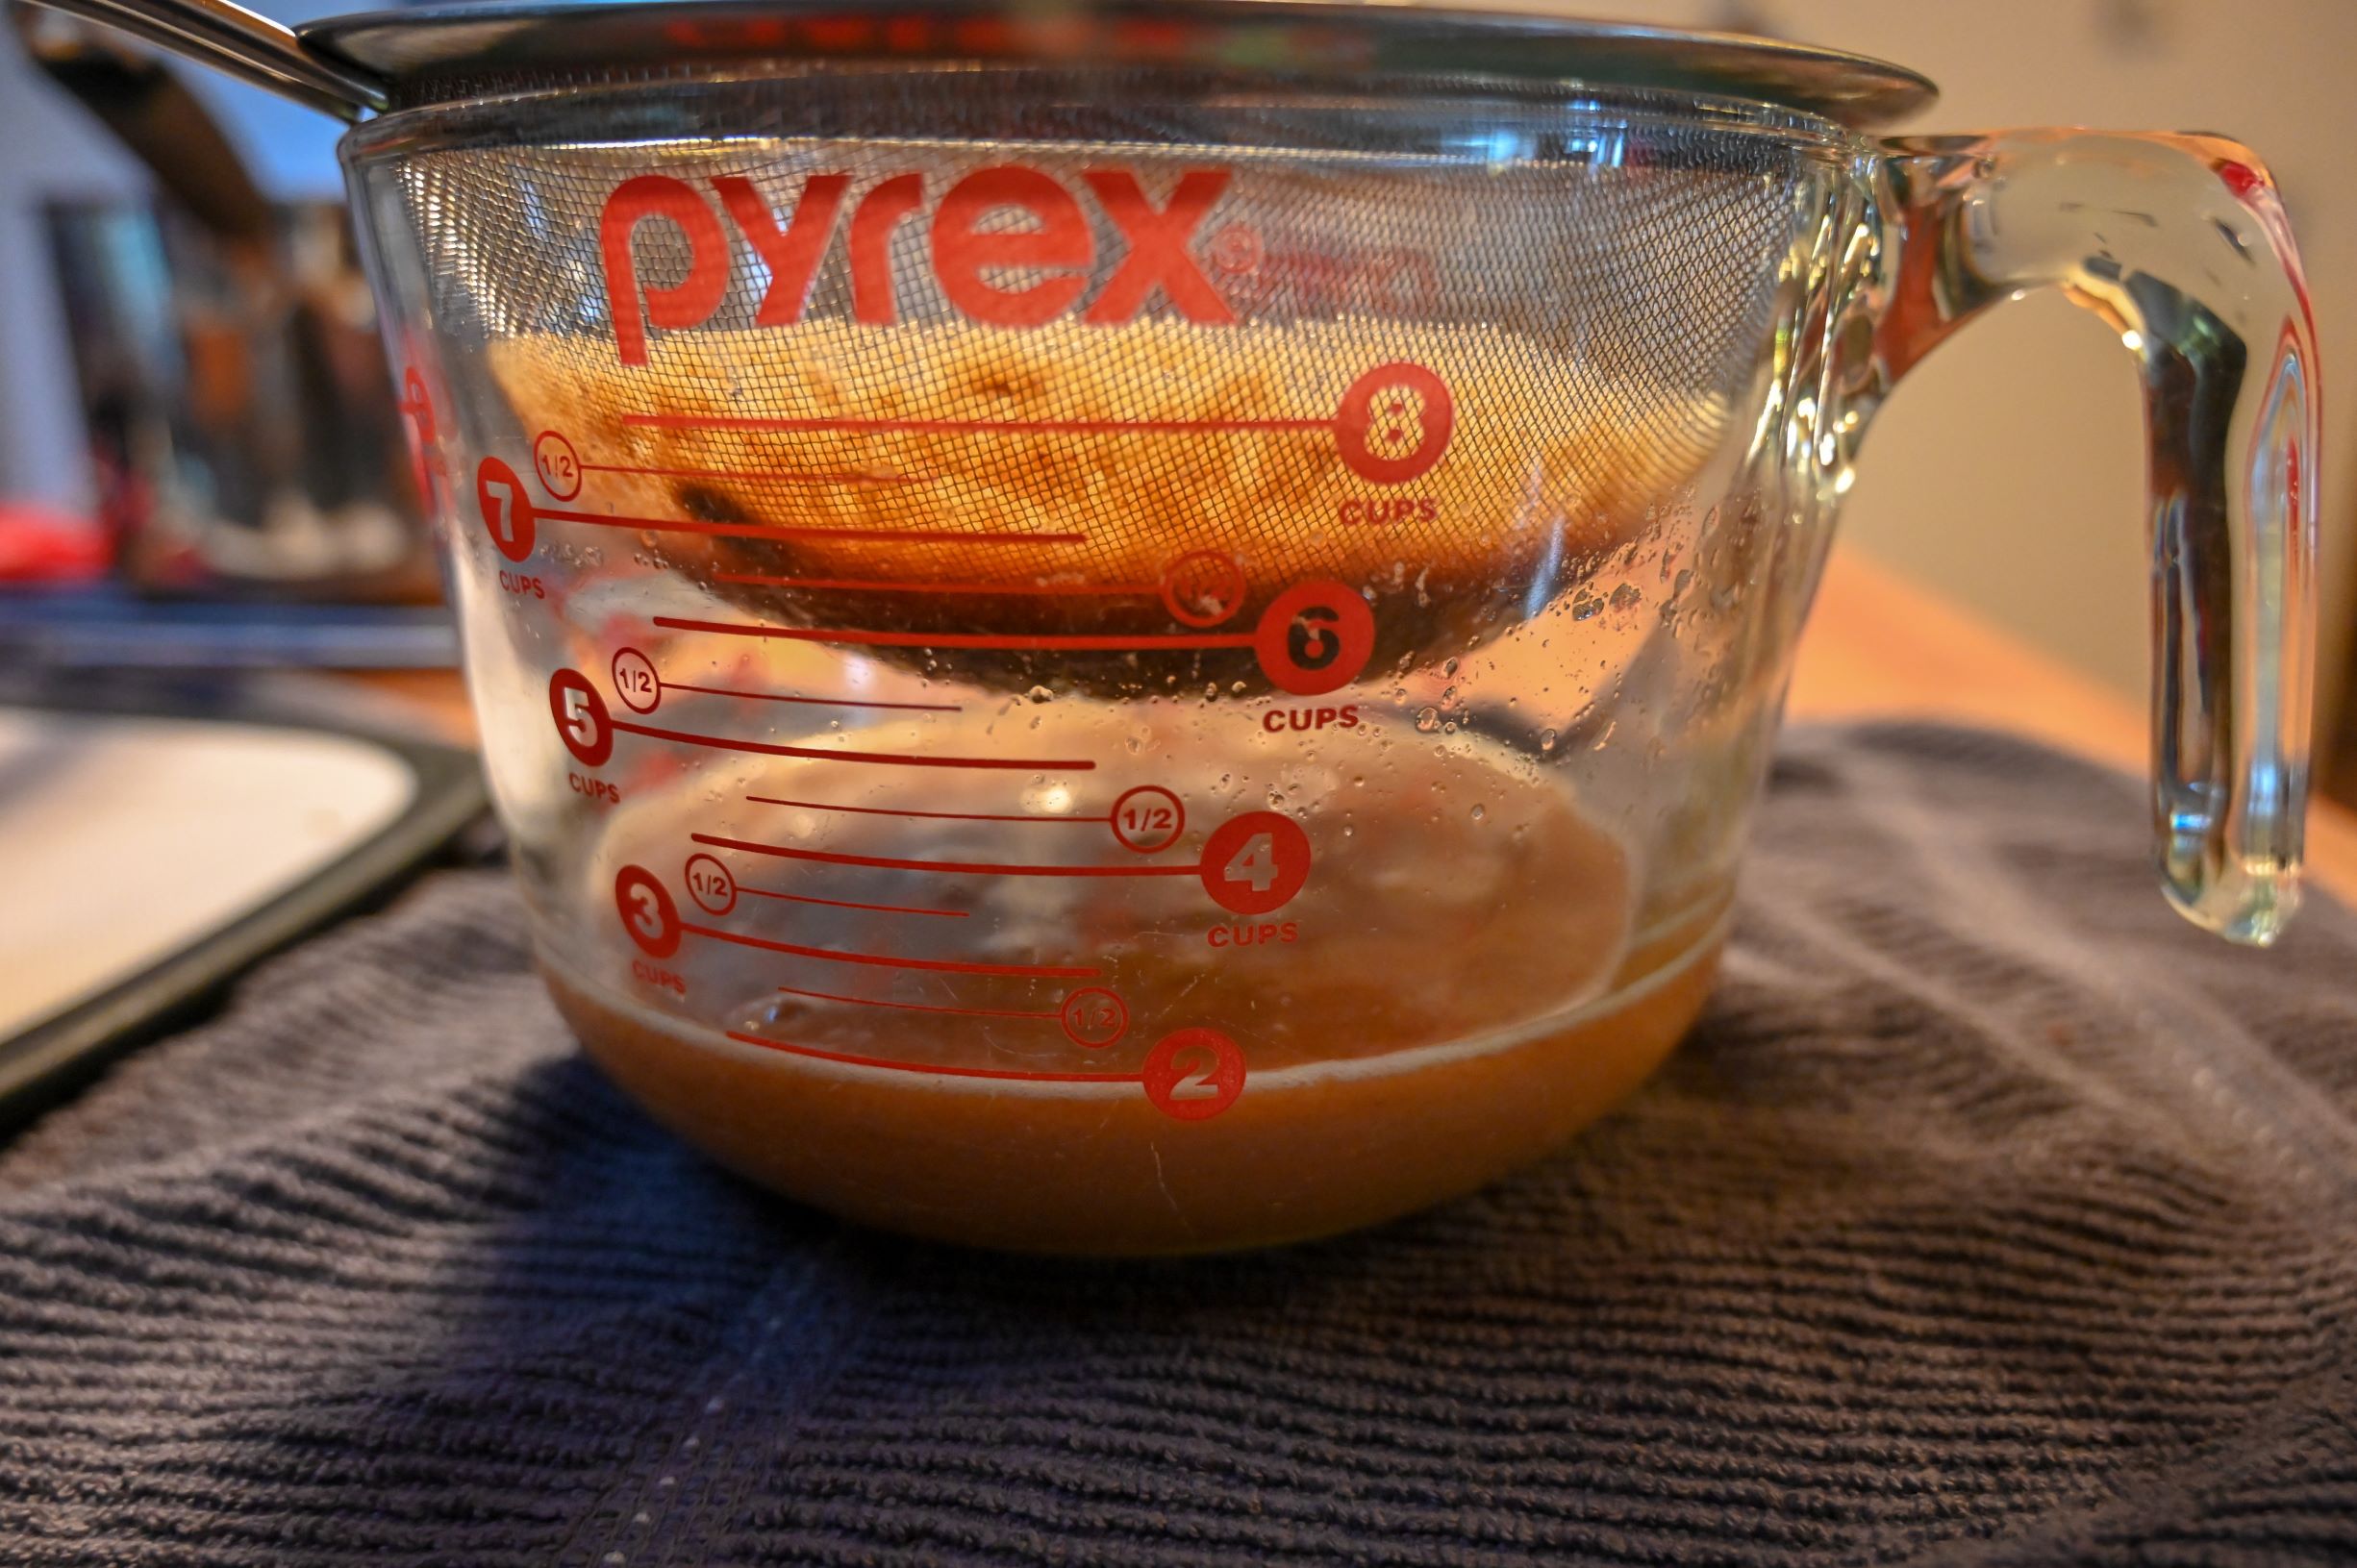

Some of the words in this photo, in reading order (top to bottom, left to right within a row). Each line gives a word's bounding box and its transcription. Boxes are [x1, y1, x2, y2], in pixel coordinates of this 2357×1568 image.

[600, 165, 1238, 366] pyrex
[1365, 385, 1426, 461] 8
[541, 455, 574, 479] 1/2
[485, 480, 514, 542] 7
[1339, 498, 1438, 526] CUPS
[499, 570, 545, 600] CUPS
[1288, 607, 1341, 670] 6
[619, 667, 652, 693] 1/2
[564, 686, 598, 748] 5
[1263, 705, 1359, 733] CUPS
[568, 772, 620, 804] CUPS
[1123, 808, 1172, 832] 1/2
[1223, 833, 1278, 892] 4
[692, 872, 728, 897] 1/2
[630, 883, 664, 939] 3
[1207, 922, 1298, 948] CUPS
[632, 959, 686, 994] CUPS
[1072, 1008, 1117, 1030] 1/2
[1168, 1044, 1219, 1101] 2
